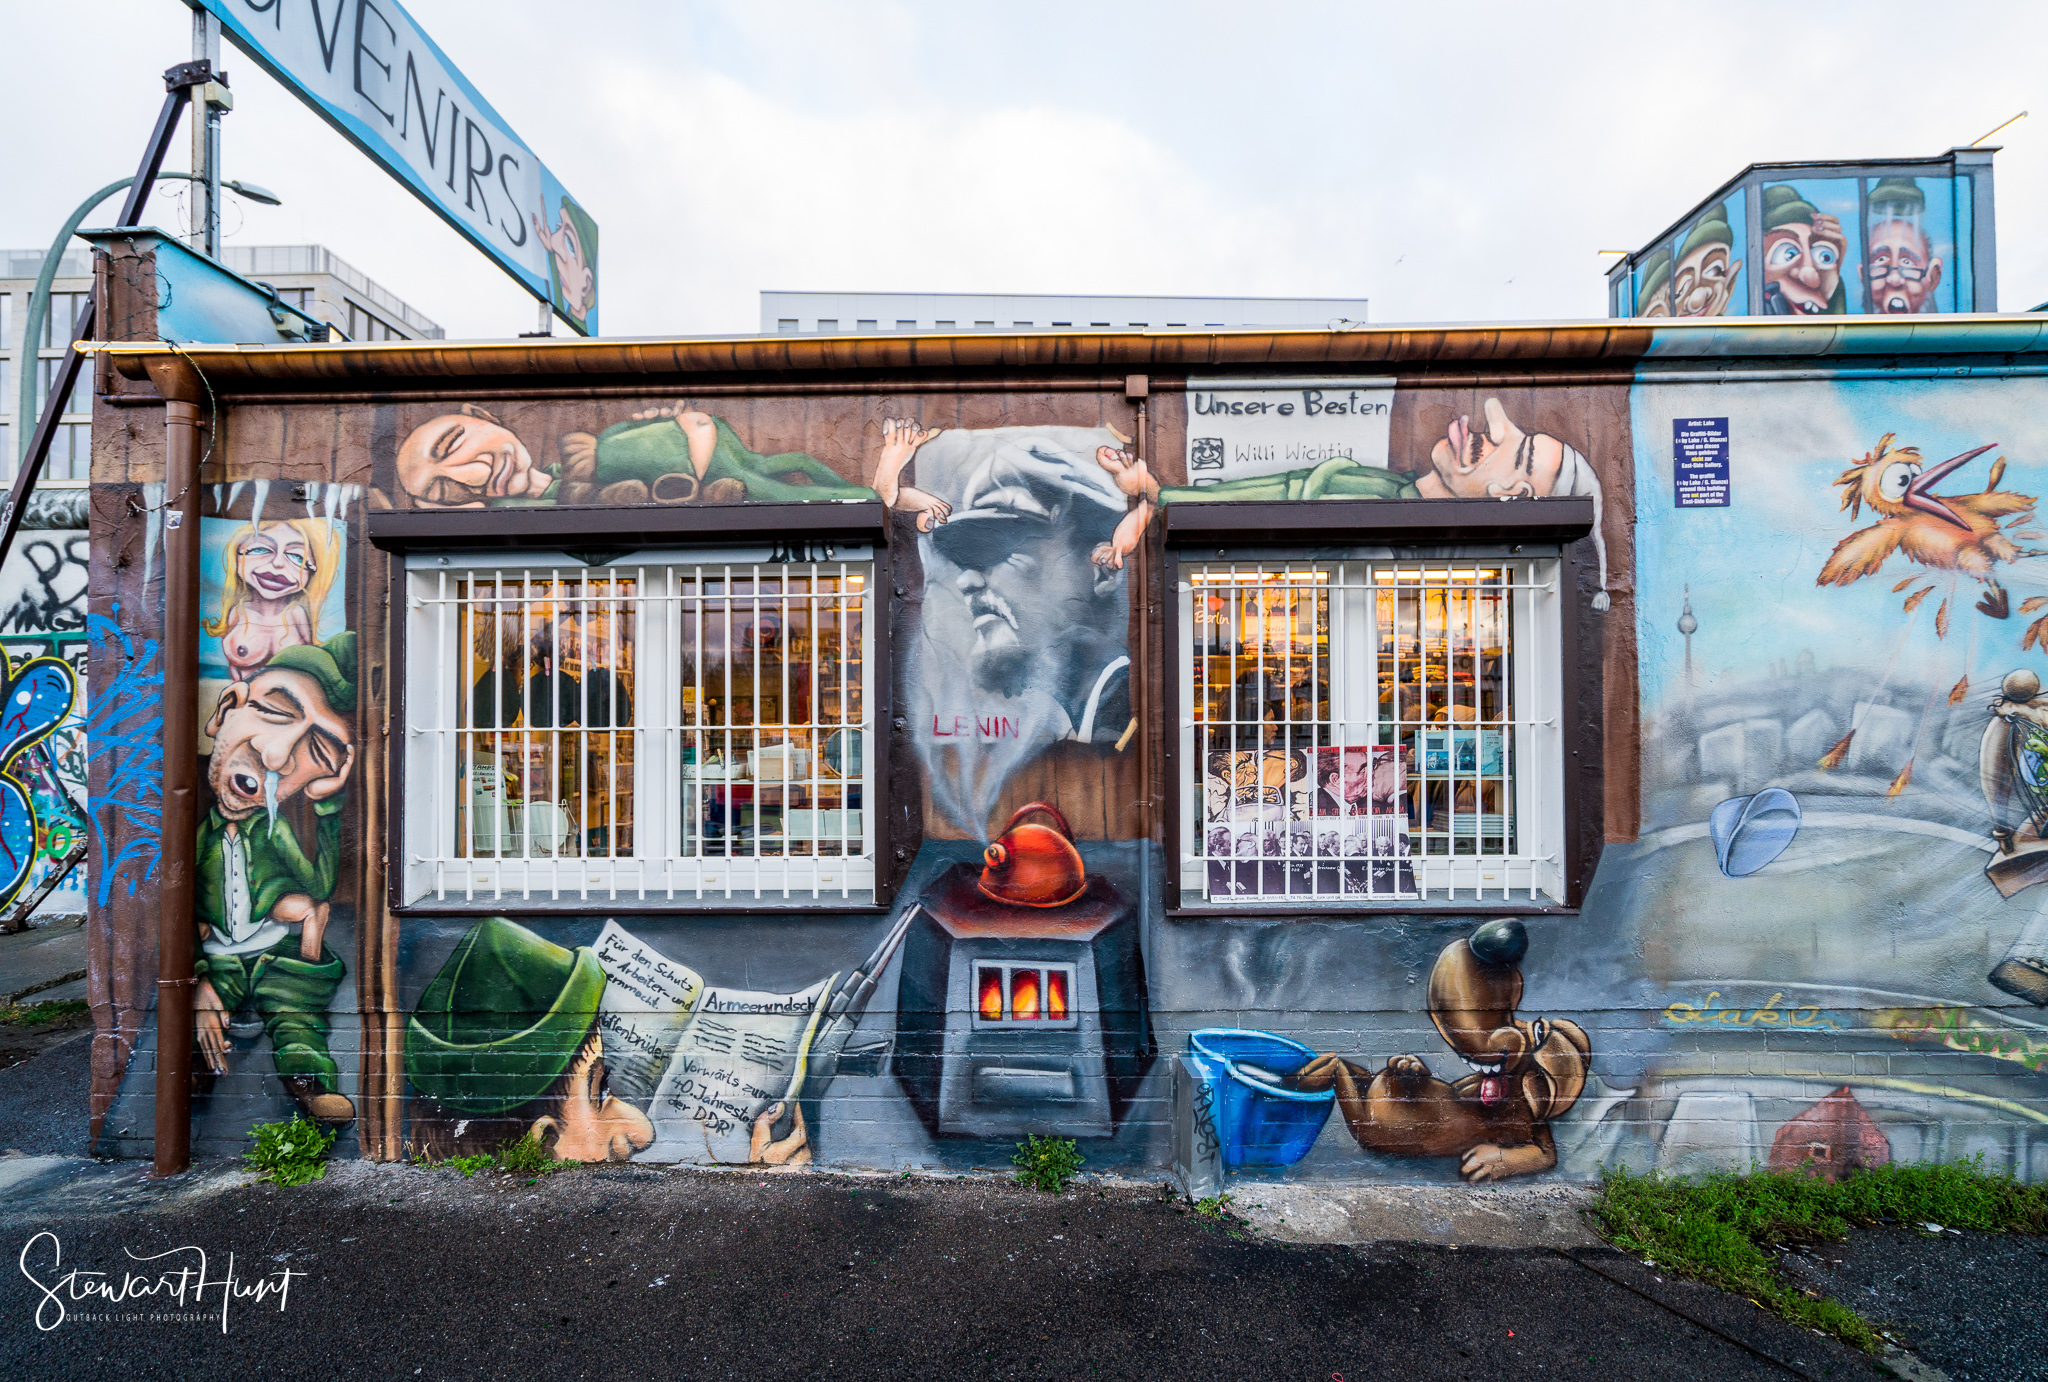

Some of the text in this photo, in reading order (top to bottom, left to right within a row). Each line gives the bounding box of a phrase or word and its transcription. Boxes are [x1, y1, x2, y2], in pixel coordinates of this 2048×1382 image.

[244, 0, 527, 247] VENIRS
[1195, 390, 1388, 417] Unsere Besten
[1235, 443, 1275, 463] Willi
[933, 714, 1020, 739] LENIN
[605, 934, 694, 993] Für den Schutz
[598, 947, 695, 1012] der Arbeiter- und
[683, 1056, 740, 1088] Vorwärts
[667, 1094, 691, 1112] der
